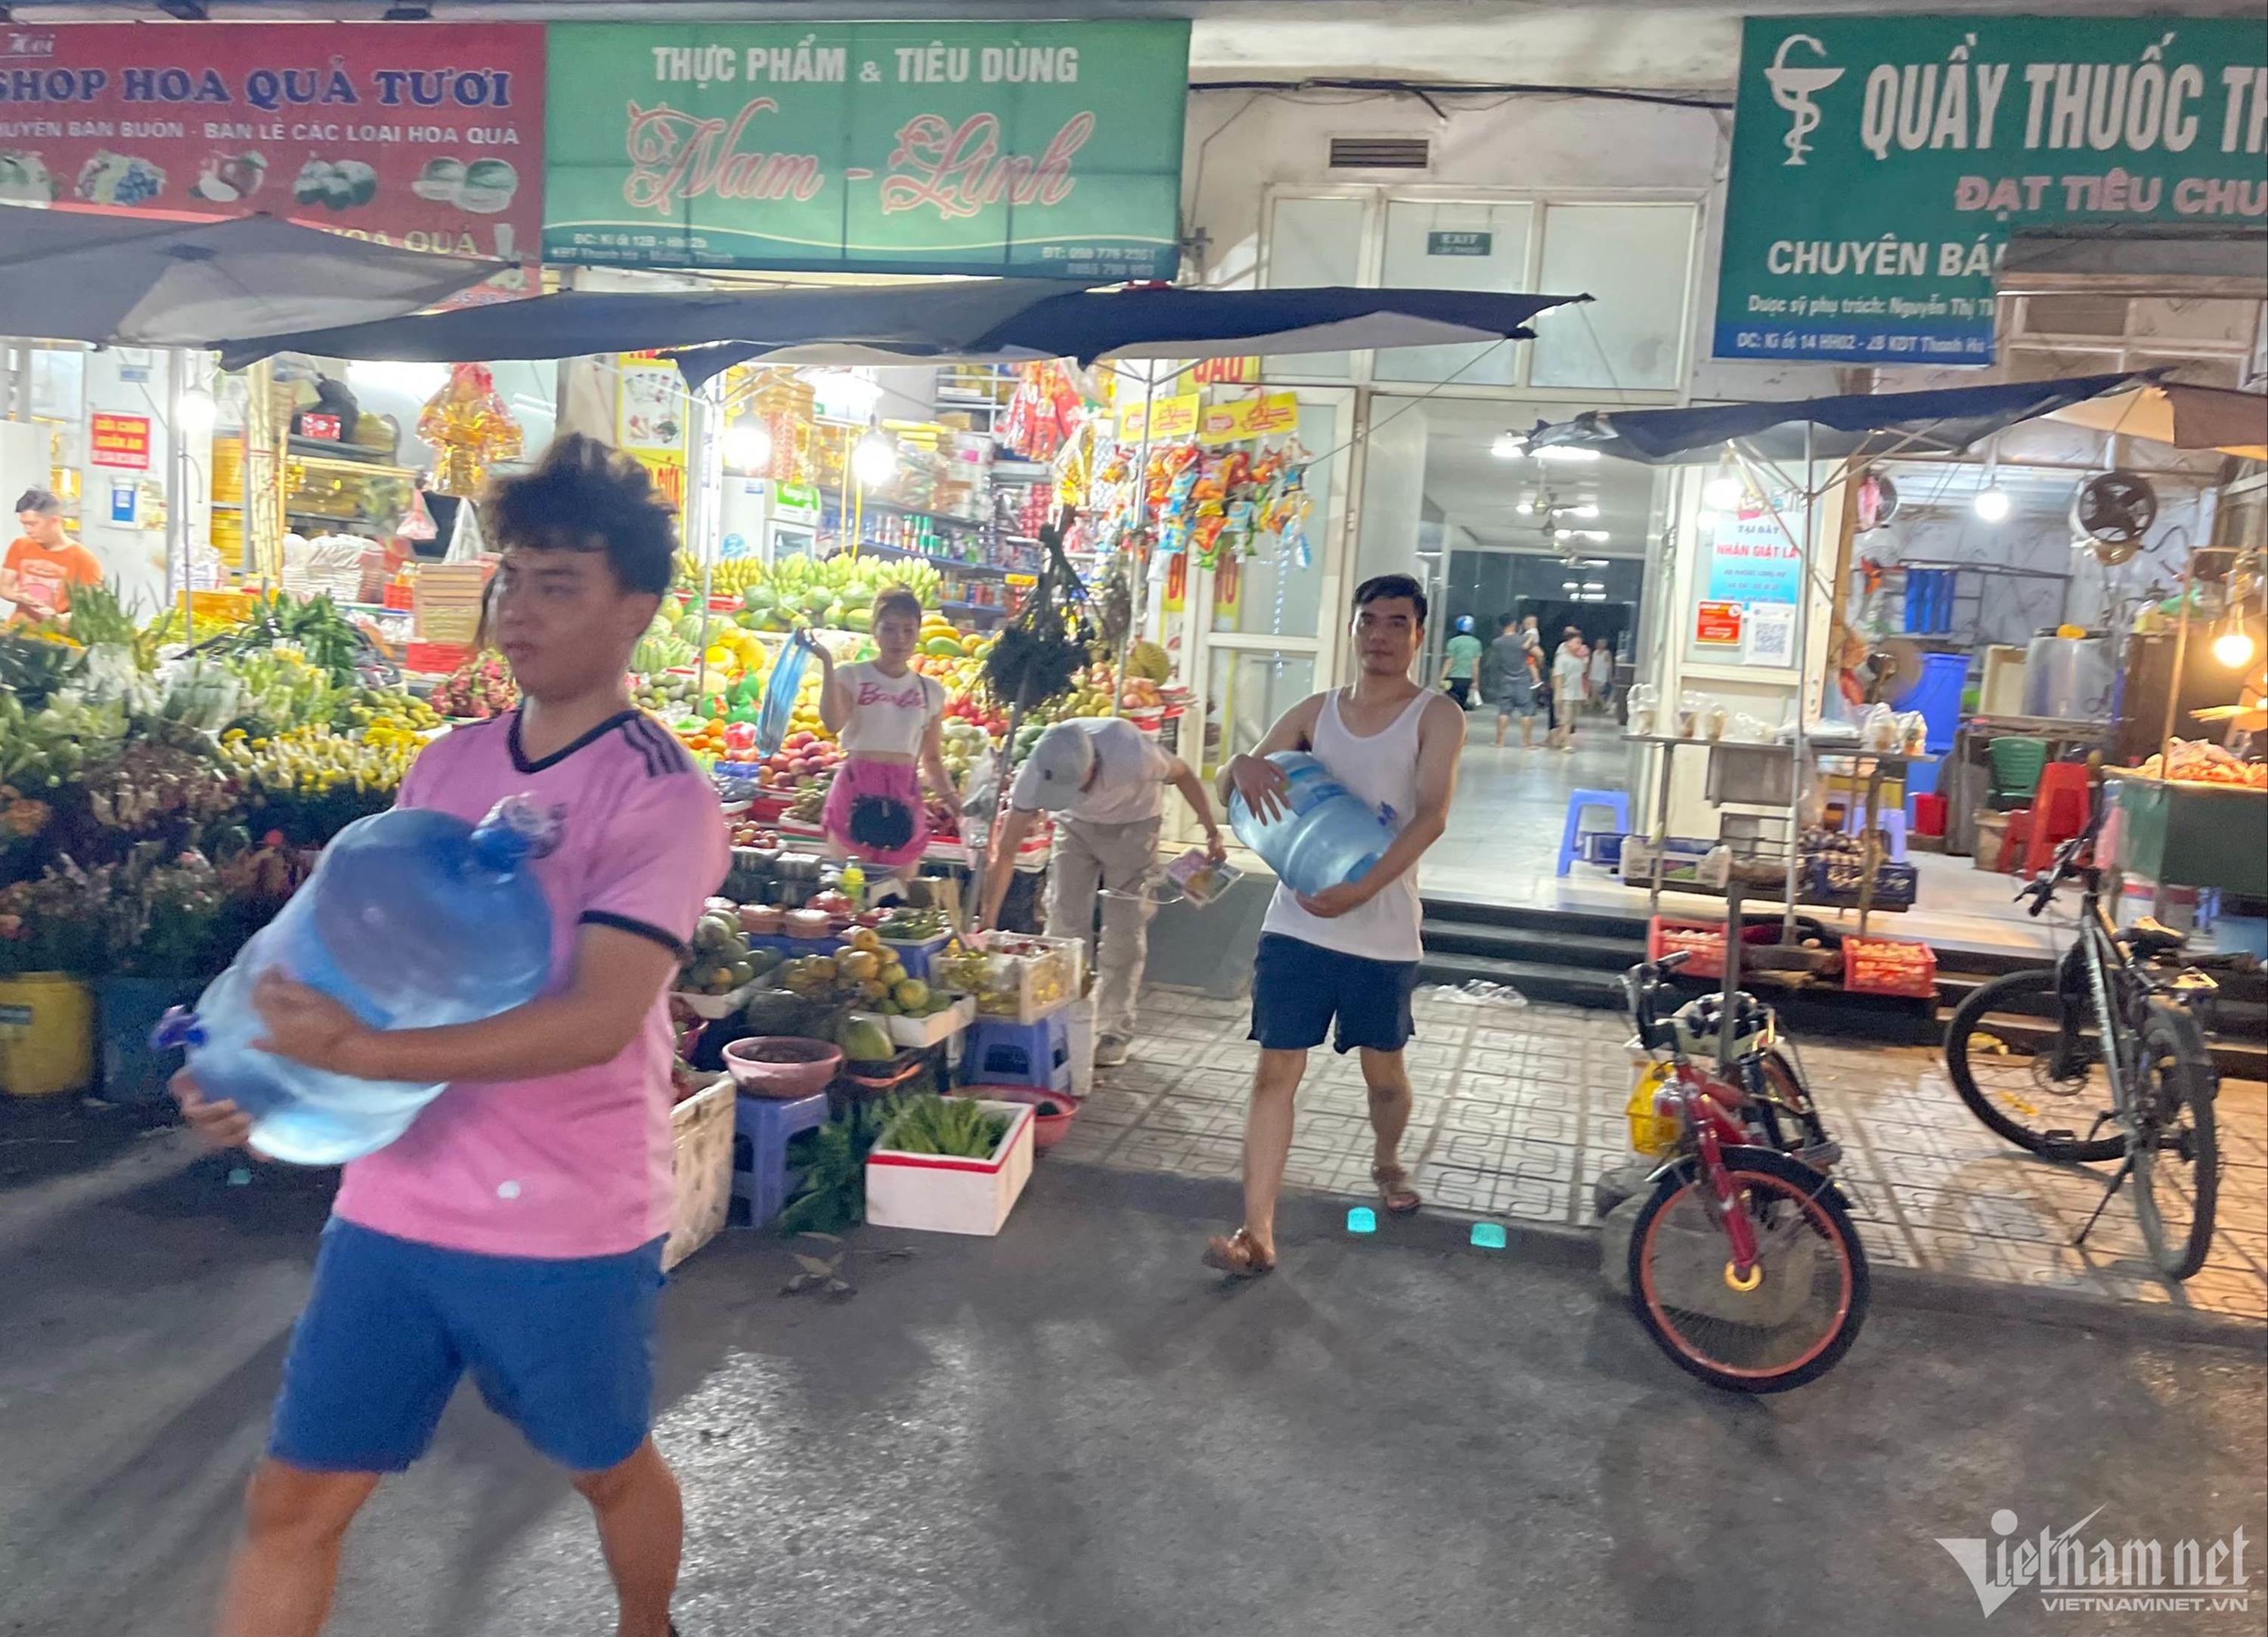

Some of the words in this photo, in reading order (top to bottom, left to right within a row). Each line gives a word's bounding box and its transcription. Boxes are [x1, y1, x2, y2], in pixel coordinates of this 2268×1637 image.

[121, 67, 232, 103] HOA
[246, 55, 361, 112] QUẢ
[374, 67, 513, 107] TƯƠI
[652, 43, 736, 89] THỰC
[745, 33, 847, 82] PHẨM
[859, 60, 881, 82] &
[894, 40, 971, 82] TIÊU
[980, 40, 1079, 83] DÙNG
[1861, 33, 2010, 160] QUẦY
[2024, 31, 2203, 151] THUỐC
[119, 117, 184, 138] BUÔN
[292, 119, 339, 141] CÁC
[345, 125, 401, 147] LOẠI
[407, 127, 459, 144] HOA
[466, 121, 519, 144] QUẢ
[624, 98, 826, 215] Nam
[881, 111, 1095, 218] Linh
[1955, 175, 2053, 222] ĐẠT
[2062, 166, 2162, 212] TIÊU
[2173, 178, 2268, 216] CHU
[1767, 232, 1929, 275] CHUYÊN
